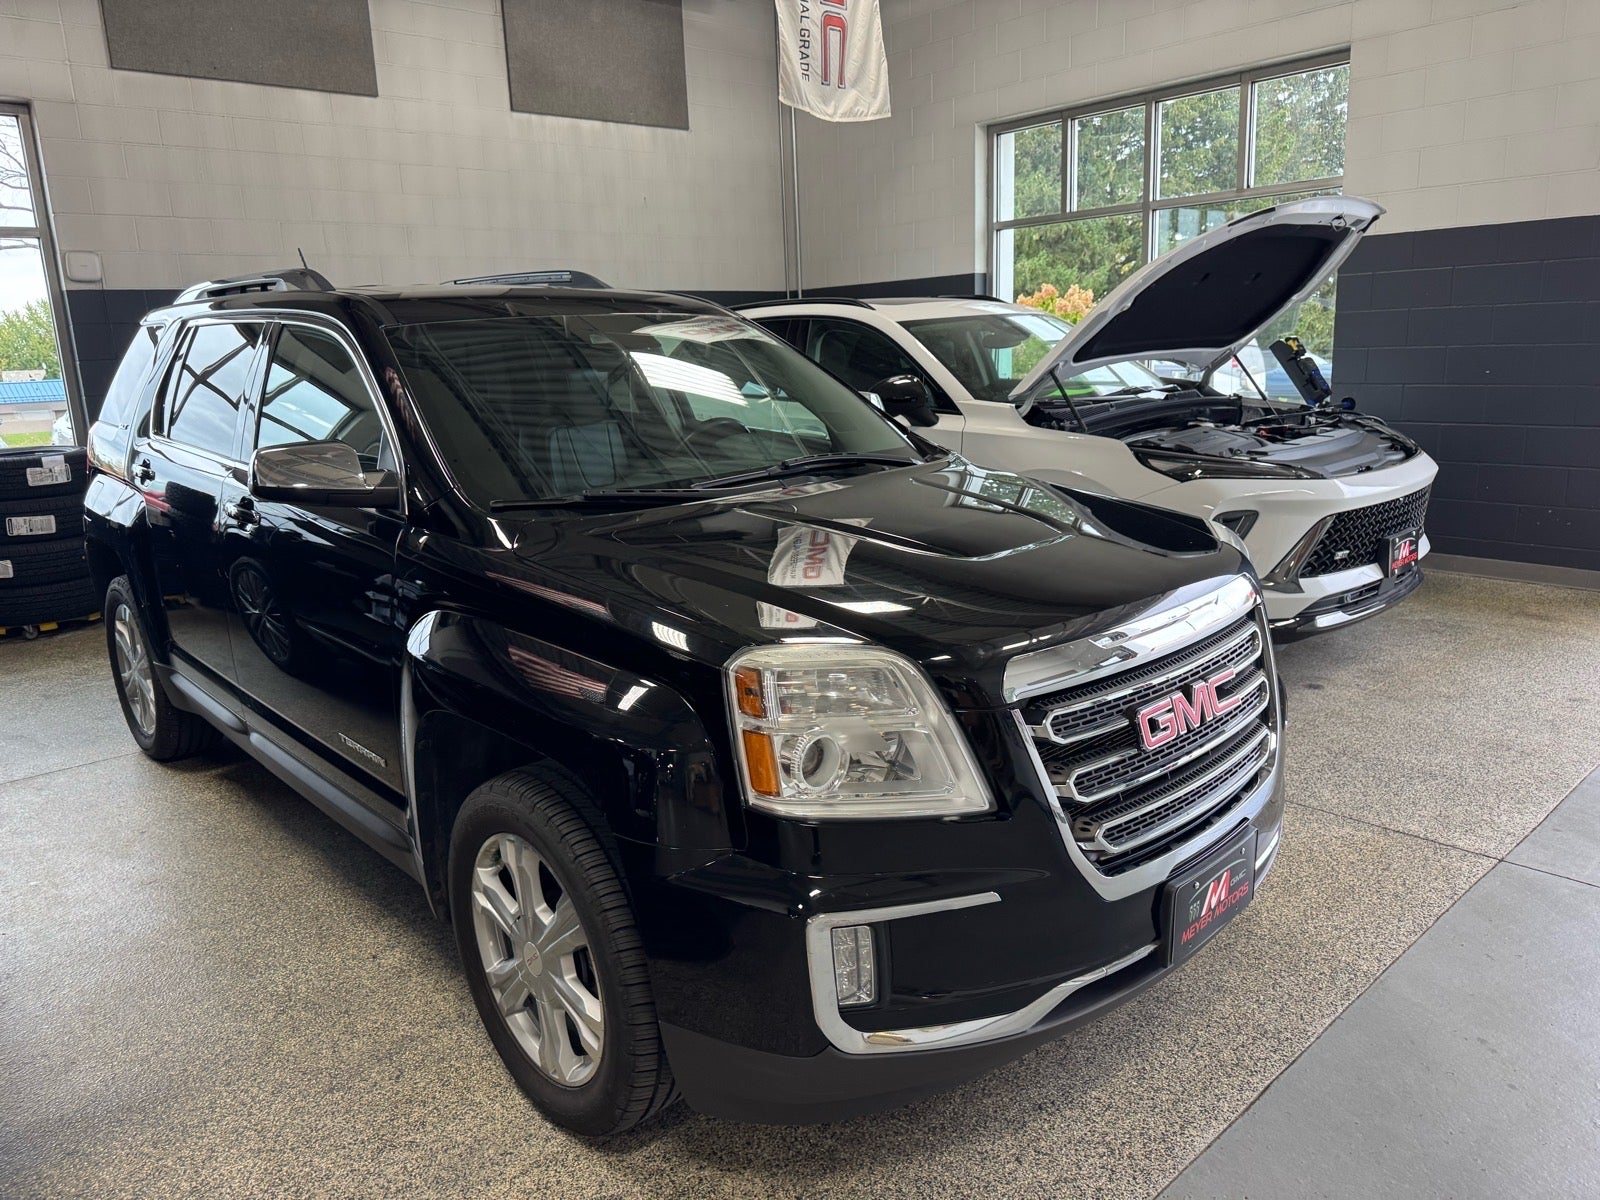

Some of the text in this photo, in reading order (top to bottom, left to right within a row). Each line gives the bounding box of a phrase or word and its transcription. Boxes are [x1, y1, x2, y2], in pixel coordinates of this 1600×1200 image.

[798, 28, 811, 82] GRADE
[1138, 667, 1241, 751] GMC
[1229, 868, 1247, 887] GMC
[1181, 881, 1249, 945] MEYER MOTORS
